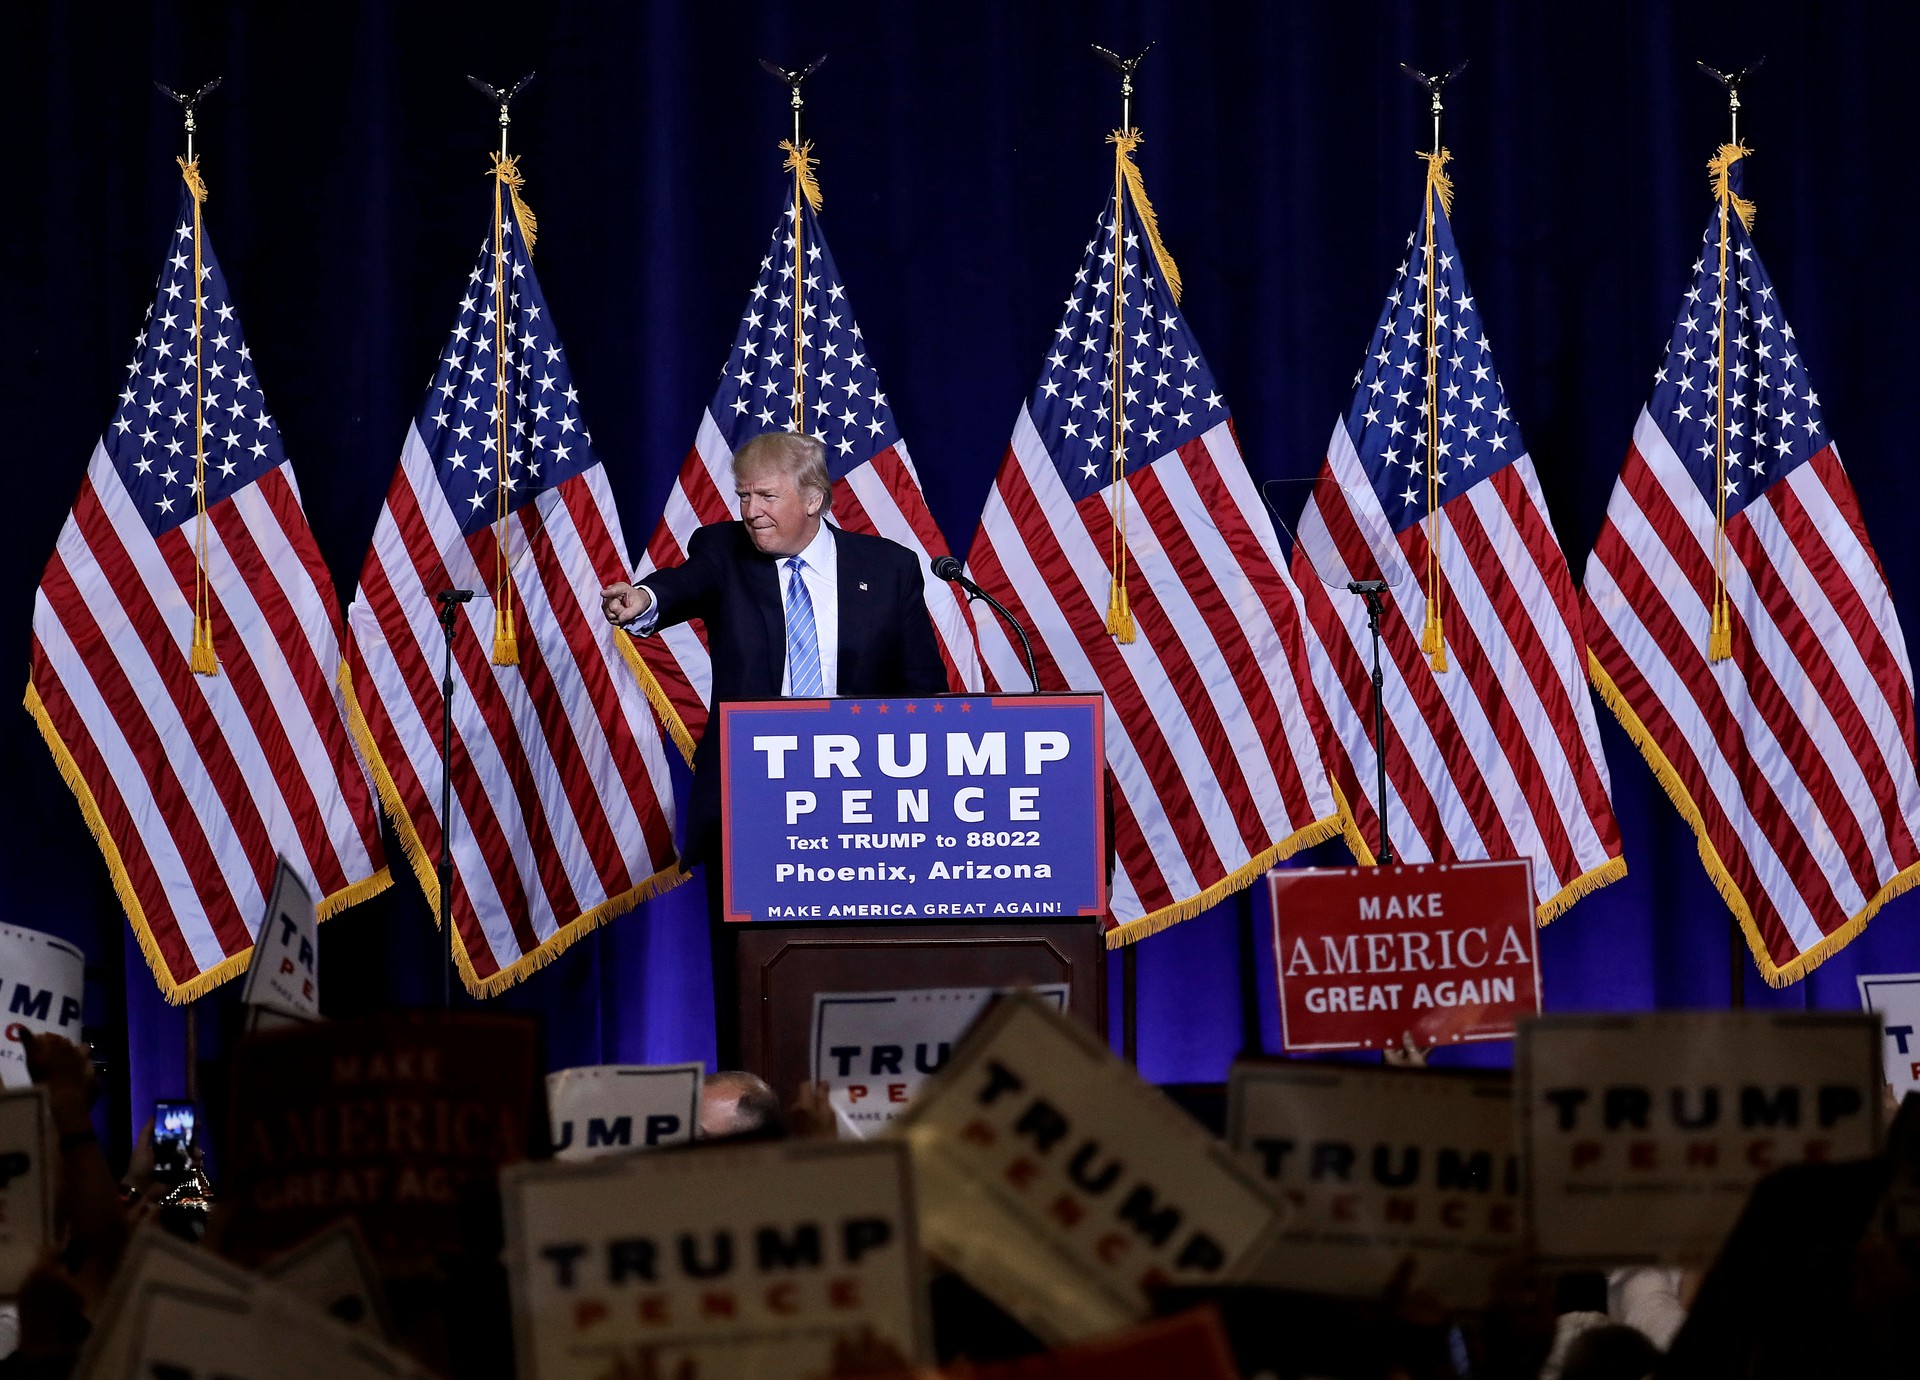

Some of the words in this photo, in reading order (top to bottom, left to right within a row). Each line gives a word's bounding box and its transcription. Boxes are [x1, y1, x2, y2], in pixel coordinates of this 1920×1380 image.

[753, 731, 1070, 779] TRUMP
[785, 786, 1040, 825] PENCE
[786, 835, 829, 850] Text
[838, 832, 926, 849] TRUMP
[936, 834, 956, 848] to
[966, 831, 1040, 847] 88022
[775, 862, 917, 883] Phoenix,
[928, 861, 1052, 880] Arizona
[768, 905, 822, 917] MAKE
[828, 904, 917, 917] AMERICA
[924, 903, 986, 915] GREAT
[993, 902, 1062, 914] AGAIN!
[1359, 893, 1444, 921] MAKE
[1285, 925, 1531, 977] AMERICA
[1305, 984, 1403, 1014] GREAT
[1412, 977, 1516, 1010] AGAIN
[830, 1042, 951, 1076] TRU
[1545, 1084, 1863, 1132] TRUMP
[979, 1059, 1223, 1274] TRUMP
[540, 1218, 890, 1289] TRUMP
